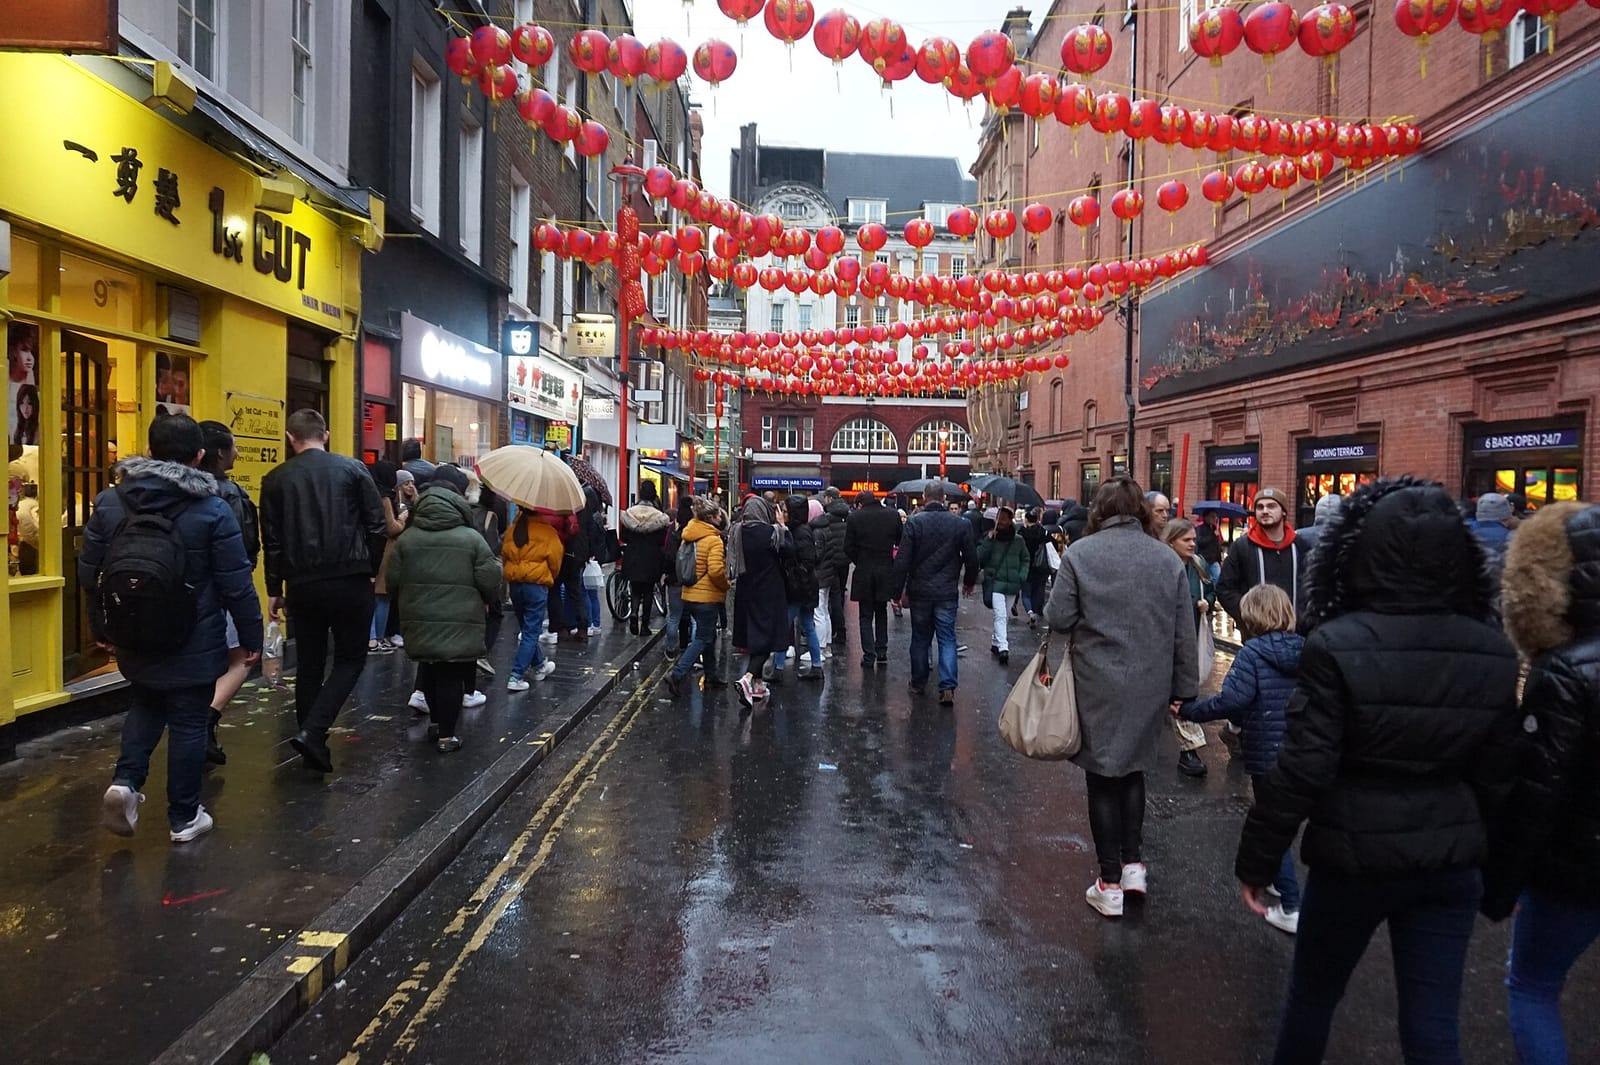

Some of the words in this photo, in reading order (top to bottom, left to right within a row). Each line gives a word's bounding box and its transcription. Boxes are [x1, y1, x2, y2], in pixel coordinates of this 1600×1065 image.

[208, 186, 243, 264] 1st
[253, 210, 311, 291] CUT
[94, 280, 108, 308] 9
[1485, 437, 1491, 448] 6
[1491, 436, 1514, 448] BARS
[1514, 434, 1541, 446] OPEN
[1541, 432, 1562, 445] 24/7
[260, 447, 278, 463] £12
[1313, 448, 1337, 458] SMOKING
[1337, 446, 1364, 457] TERRACES
[802, 479, 822, 487] STATION
[852, 481, 879, 491] ANGUS
